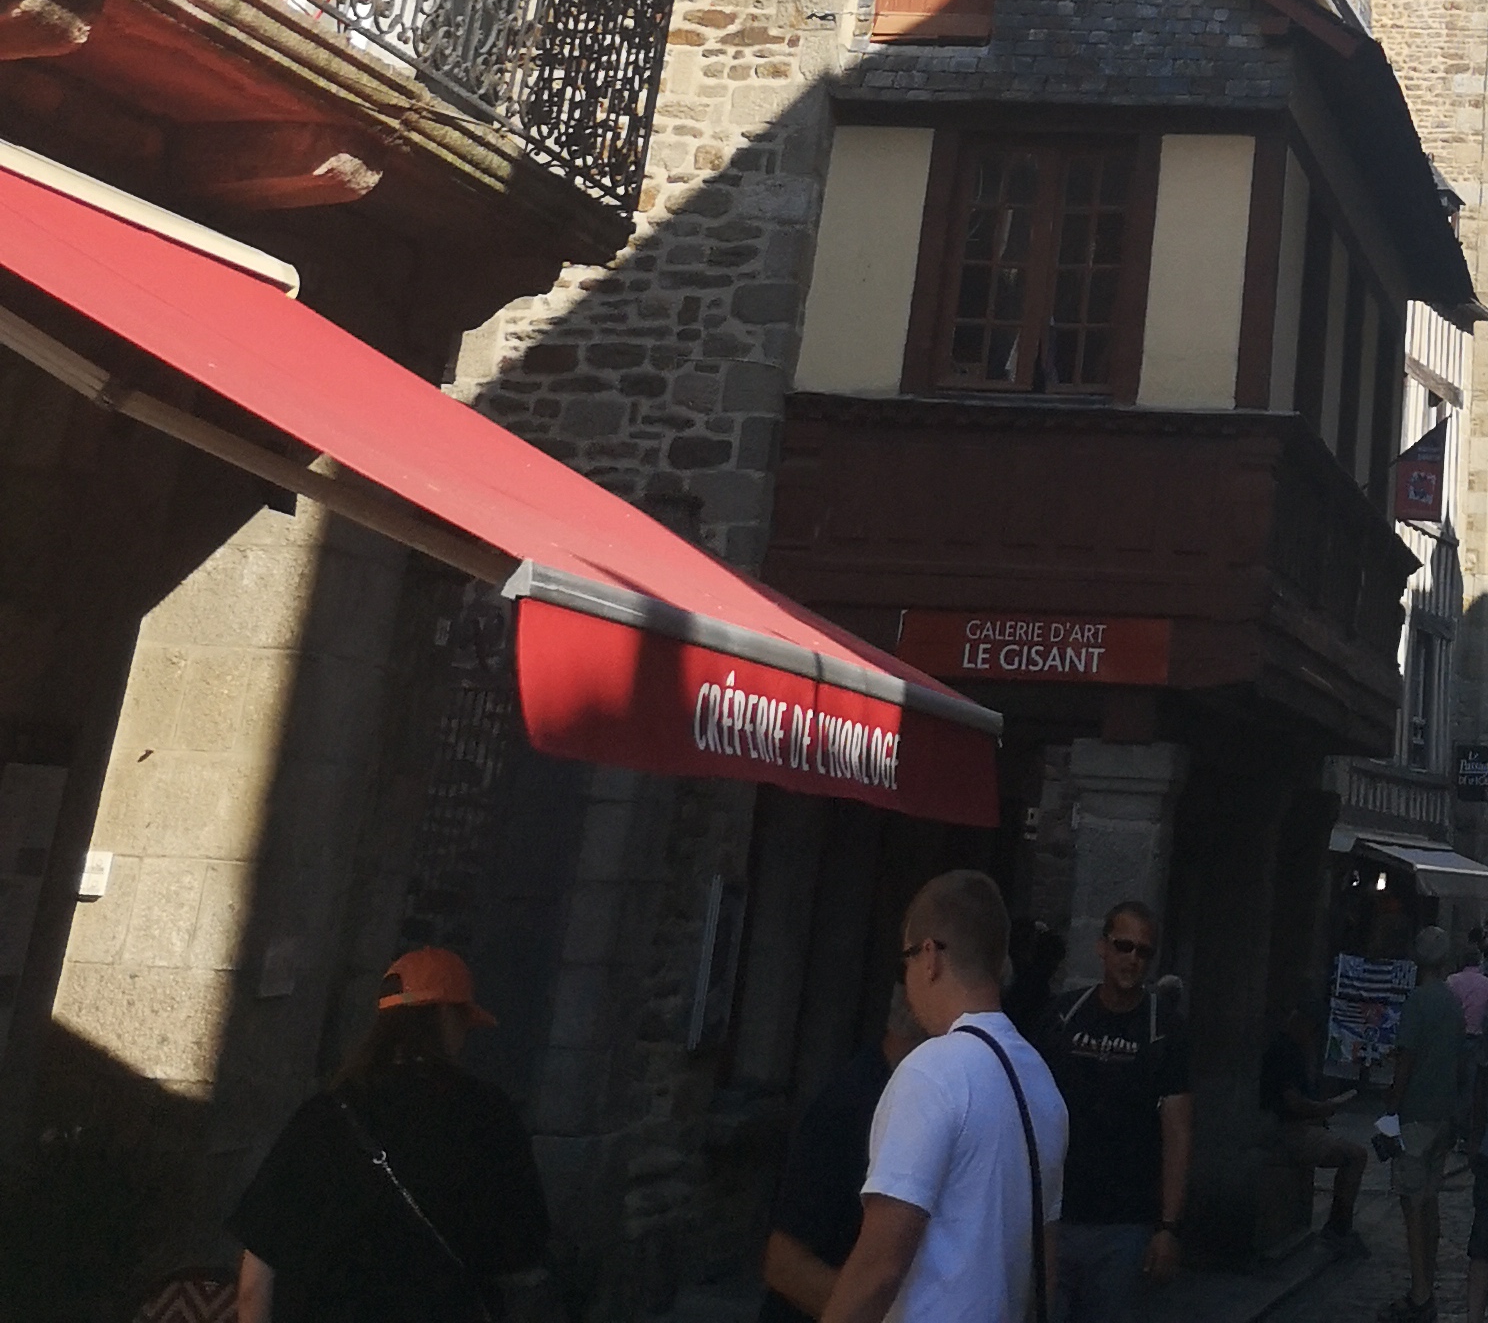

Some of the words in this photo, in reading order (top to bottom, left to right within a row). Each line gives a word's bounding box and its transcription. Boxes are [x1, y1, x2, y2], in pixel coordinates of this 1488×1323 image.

[966, 620, 1044, 642] GALERIE
[1050, 622, 1107, 643] D'ART
[962, 643, 992, 670] LE
[1000, 645, 1106, 673] GISANT
[694, 670, 788, 765] CRÊPERIE
[790, 704, 814, 772] DE
[816, 712, 900, 790] L'HORLOGE
